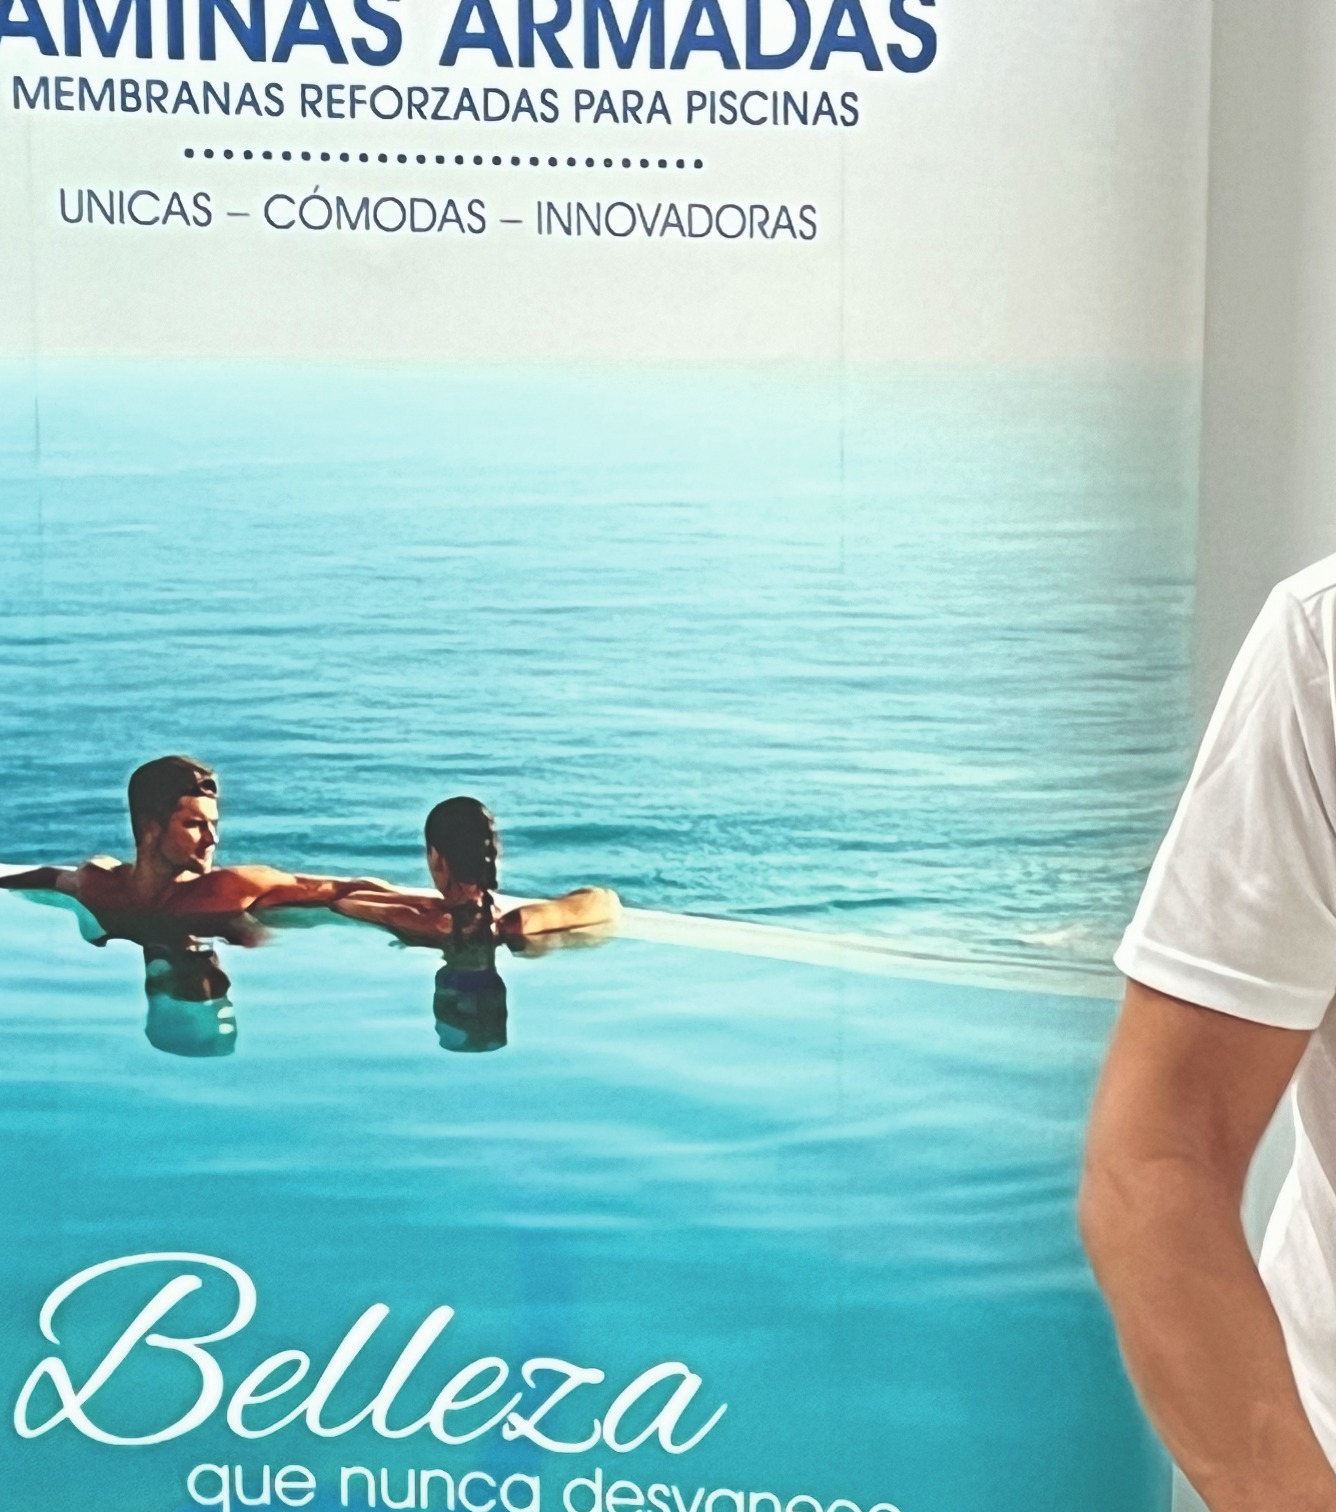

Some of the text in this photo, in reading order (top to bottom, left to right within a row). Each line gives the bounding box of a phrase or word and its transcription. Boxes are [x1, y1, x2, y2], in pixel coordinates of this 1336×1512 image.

[438, 0, 938, 74] ARMADAS
[12, 75, 860, 127] MEMBRANAS REFORZADAS PARA PISCINAS
[60, 188, 212, 228] UNICAS
[263, 184, 487, 235] CÓMODAS
[536, 200, 818, 241] INNOVADORAS
[13, 1252, 728, 1455] Belleza
